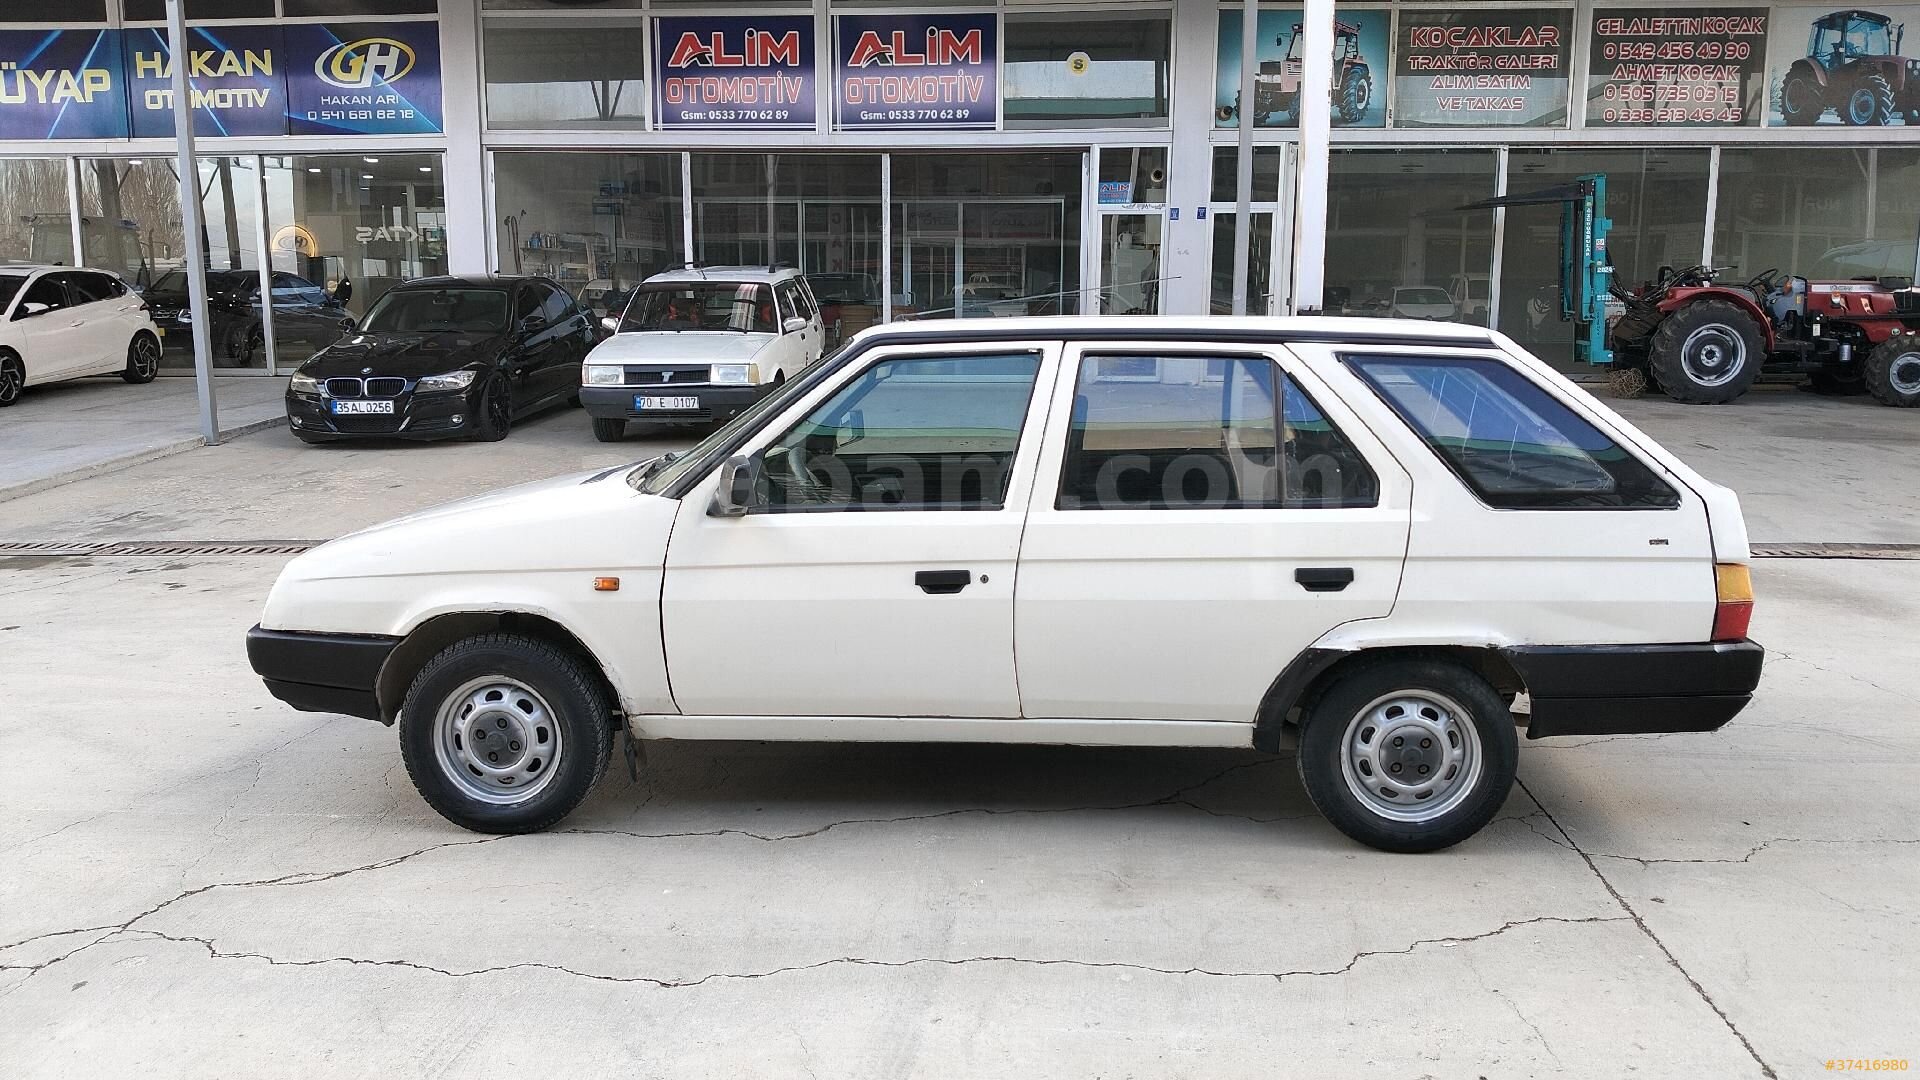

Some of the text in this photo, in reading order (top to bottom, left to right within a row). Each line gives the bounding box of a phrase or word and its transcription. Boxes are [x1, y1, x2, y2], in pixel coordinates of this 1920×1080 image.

[1702, 16, 1766, 40] KOÇAK
[1410, 25, 1560, 54] KOÇAKLAR
[1604, 41, 1750, 60] 0 542 456 49 90
[1408, 52, 1493, 70] TRAKTÖR
[1429, 74, 1531, 90] ALIM SATIM
[1611, 63, 1740, 86] AHMET KOÇAK
[321, 94, 399, 106] HAKAN ARI
[1604, 84, 1738, 102] 0 505 735 03 15
[1436, 95, 1525, 112] VE TAKAS
[321, 110, 345, 120] 541
[348, 110, 373, 120] 681
[376, 109, 396, 119] 82
[399, 109, 414, 119] 18
[680, 110, 789, 120] Gsm: 0533 770 62 89
[860, 109, 970, 120] Gsm: 0533 770 62 89
[1604, 107, 1742, 122] 0 338 213 46 45
[640, 397, 697, 408] 70 E 0107
